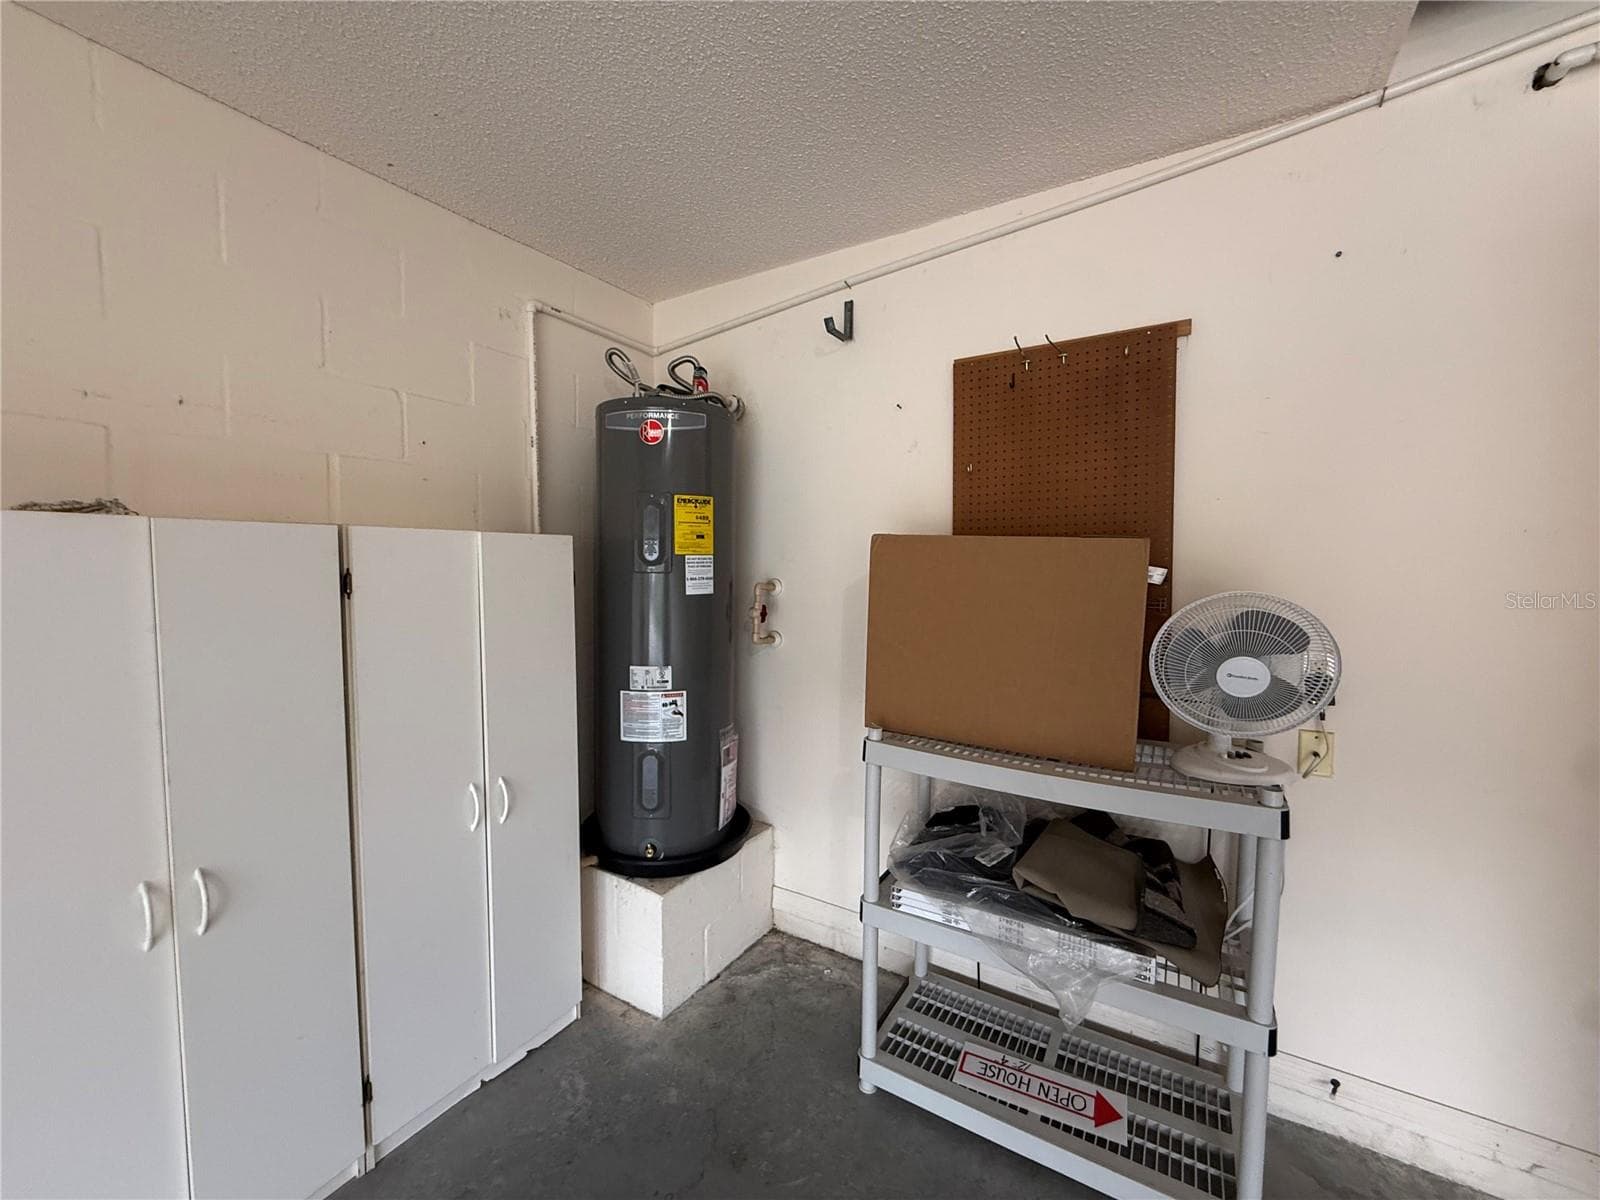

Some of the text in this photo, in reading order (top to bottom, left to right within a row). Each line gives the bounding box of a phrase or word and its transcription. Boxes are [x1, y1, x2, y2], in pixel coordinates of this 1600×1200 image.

[626, 412, 680, 420] PERFORMANCE
[641, 420, 664, 441] Rheem
[977, 1061, 1087, 1112] OPEN HOUSE
